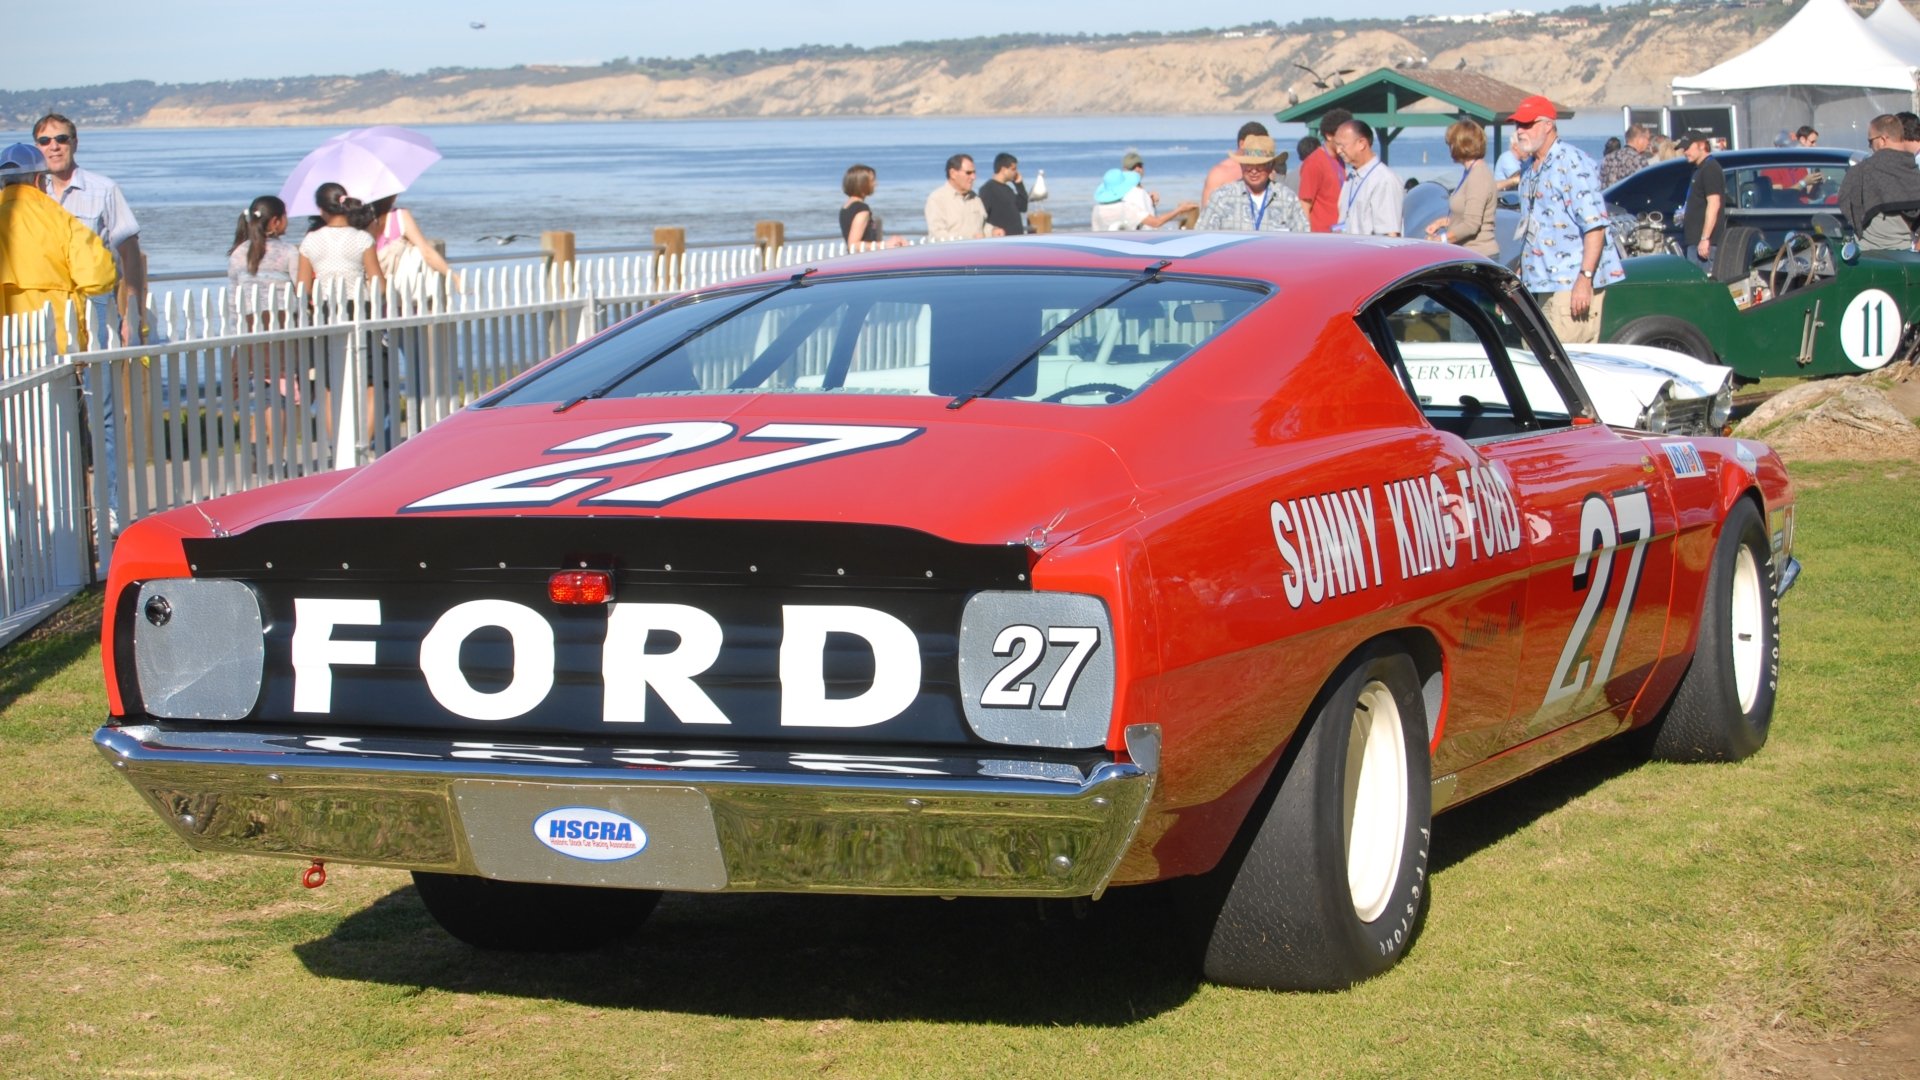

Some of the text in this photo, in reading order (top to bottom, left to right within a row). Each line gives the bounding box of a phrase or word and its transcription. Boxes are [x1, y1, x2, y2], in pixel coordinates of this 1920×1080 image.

[1861, 299, 1884, 358] 11
[396, 421, 927, 513] 27
[1269, 465, 1522, 609] SUNNY KING FORD
[1528, 485, 1655, 727] 27
[291, 597, 922, 728] FORD
[979, 623, 1101, 711] 27
[549, 819, 632, 842] HSCRA
[592, 840, 609, 850] Racing
